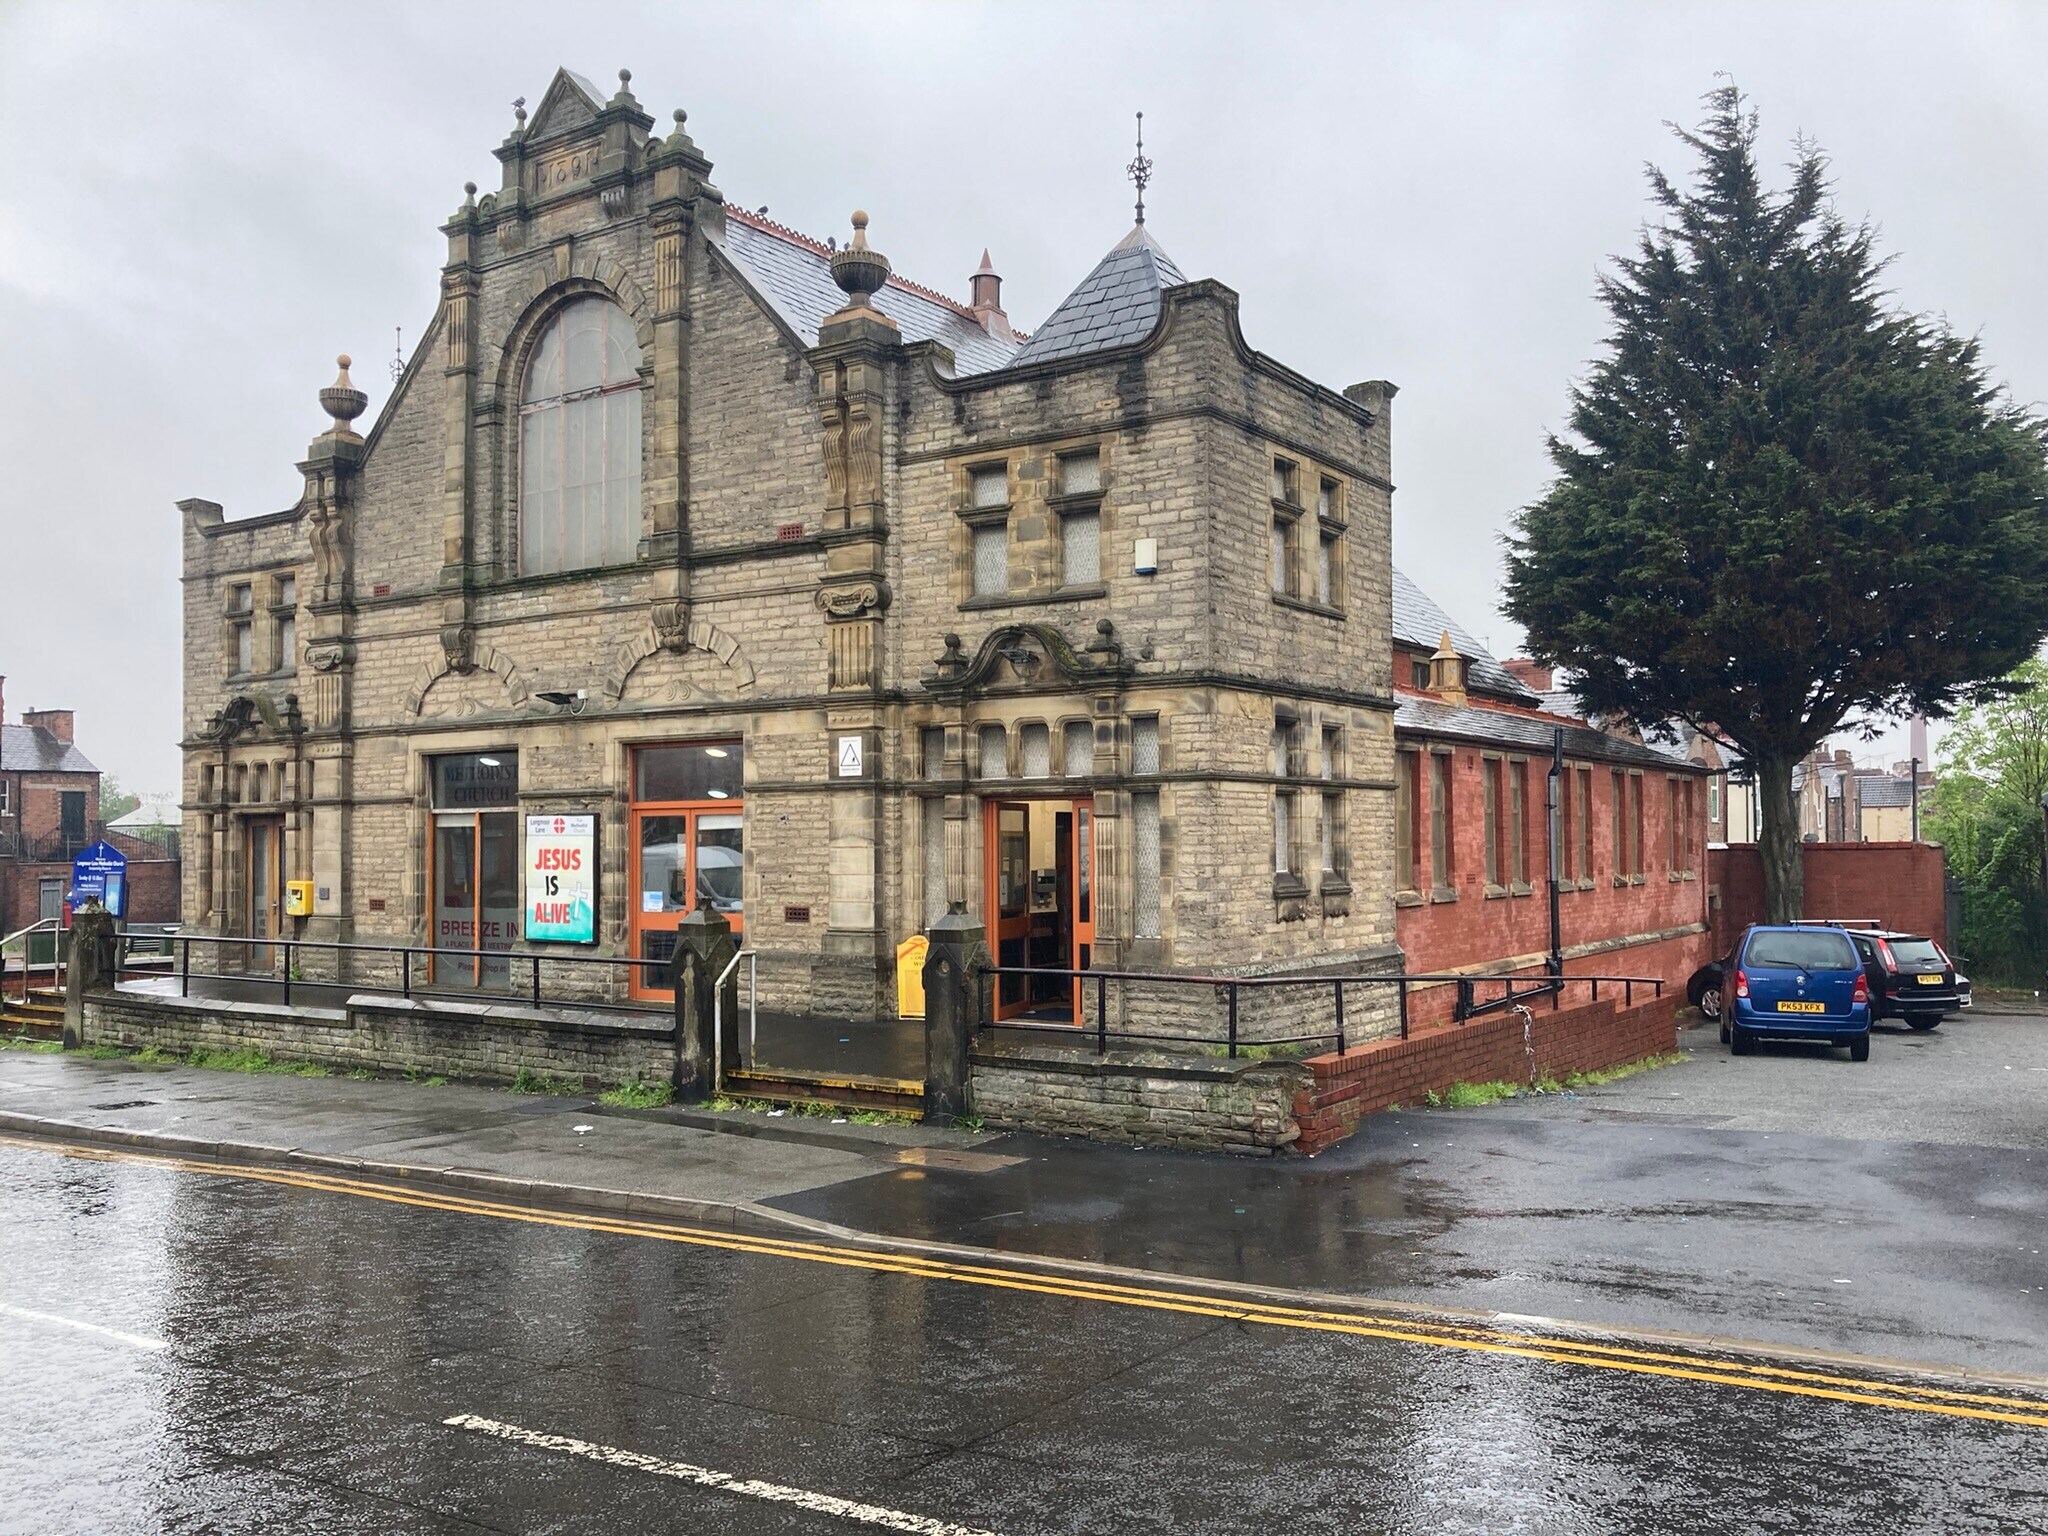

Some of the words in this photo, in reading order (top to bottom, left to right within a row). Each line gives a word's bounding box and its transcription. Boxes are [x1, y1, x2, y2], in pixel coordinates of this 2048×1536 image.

[454, 786, 509, 802] CHURCH
[535, 848, 581, 870] JESUS
[545, 875, 559, 896] IS
[534, 902, 571, 924] ALIVE
[1781, 1002, 1802, 1010] PK53
[1805, 1003, 1821, 1011] KFX
